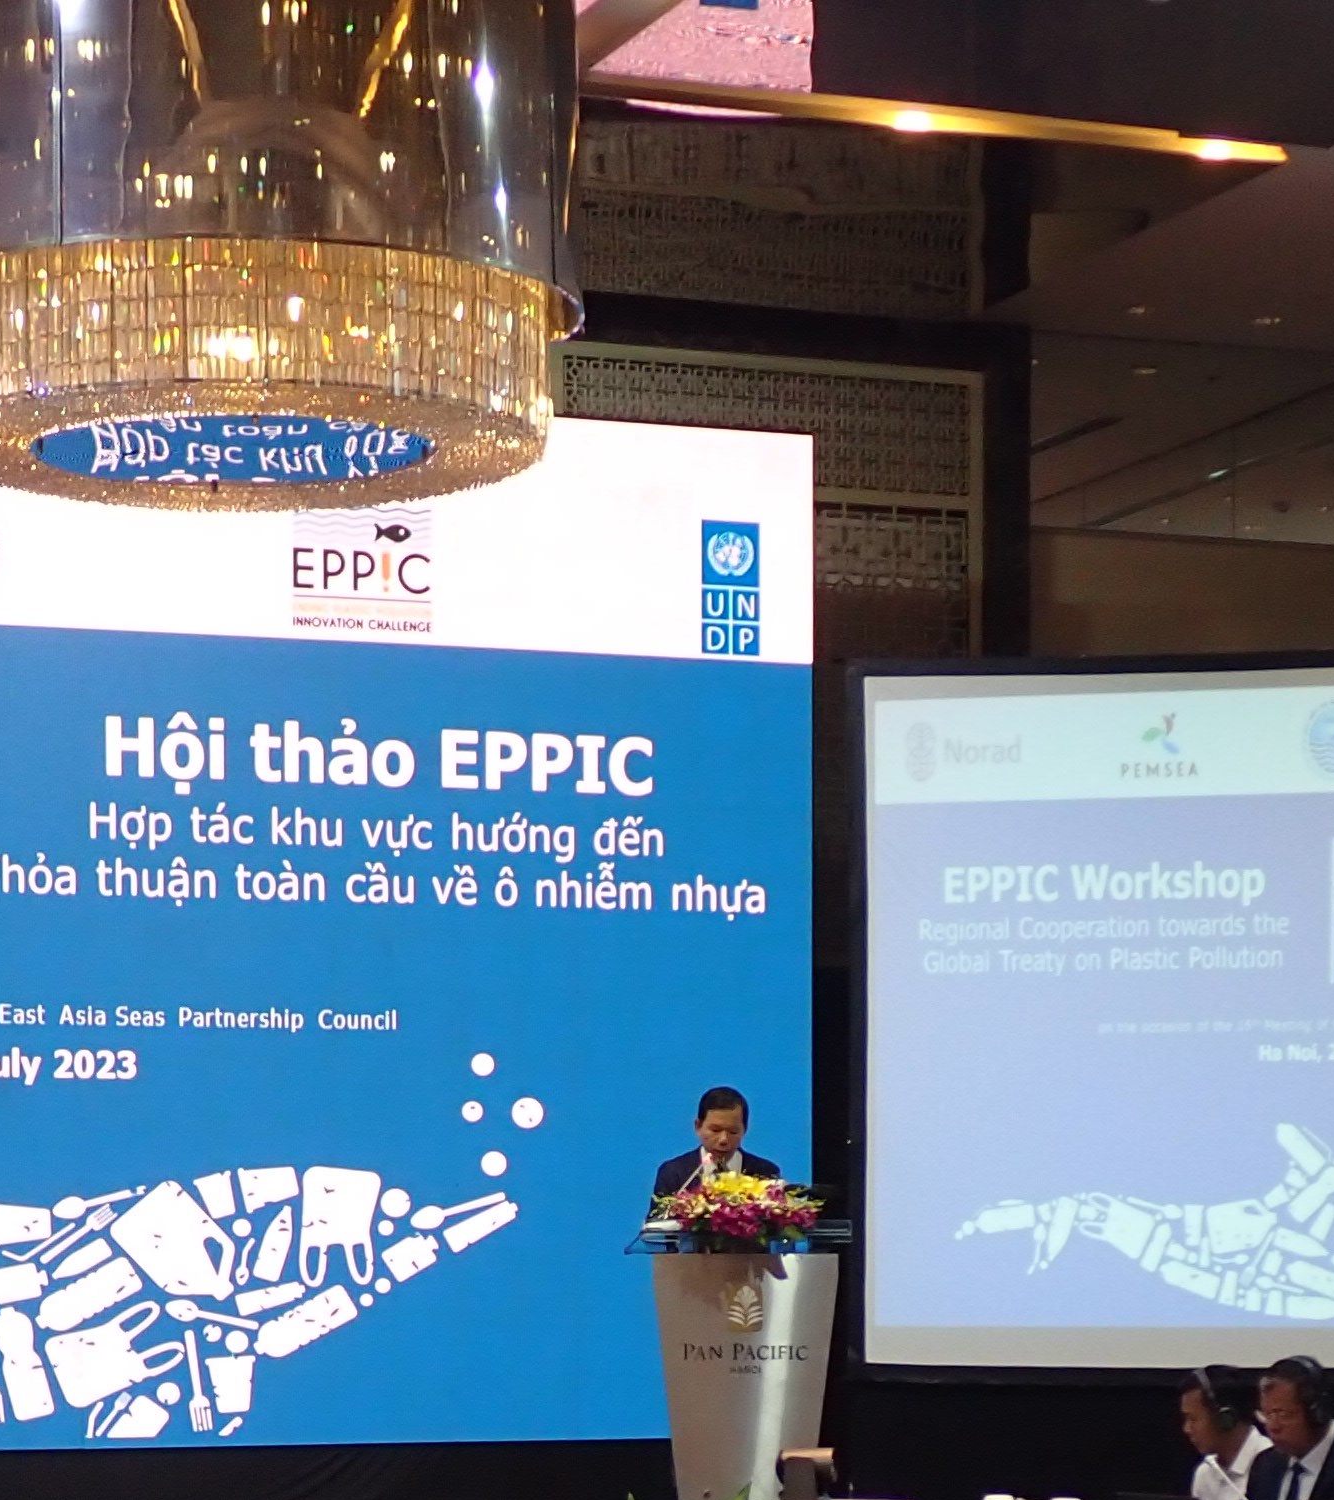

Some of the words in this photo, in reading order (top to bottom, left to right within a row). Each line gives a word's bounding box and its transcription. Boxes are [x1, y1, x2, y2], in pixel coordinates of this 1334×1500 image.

[293, 616, 364, 629] INNOVATION
[369, 619, 432, 633] CHALLENGE
[104, 712, 226, 795] Hội
[249, 716, 415, 788] thảo
[440, 727, 655, 797] EPPIC
[944, 736, 1021, 765] Norad
[1121, 762, 1200, 778] PEMSEA
[88, 802, 171, 848] Hợp
[190, 805, 254, 846] tác
[271, 806, 343, 848] khu
[364, 812, 432, 856] vực
[451, 812, 575, 864] hướng
[594, 815, 664, 858] đến
[95, 855, 217, 905] thuận
[236, 858, 325, 902] toàn
[345, 857, 416, 905] cầu
[432, 860, 478, 907] về
[495, 873, 518, 908] ô
[535, 861, 652, 911] nhiễm
[671, 876, 767, 918] nhựa
[944, 864, 1059, 903] EPPIC
[1071, 861, 1266, 906] Workshop
[919, 916, 1010, 943] Regional
[1019, 914, 1150, 942] Cooperation
[1158, 914, 1246, 938] towards
[1254, 912, 1290, 936] the
[923, 950, 990, 975] Global
[1000, 948, 1066, 977] Treaty
[1075, 954, 1101, 972] on
[1111, 946, 1180, 971] Plastic
[1189, 945, 1284, 969] Pollution
[59, 1003, 107, 1027] Asia
[115, 1005, 166, 1028] Seas
[179, 1007, 304, 1033] Partnership
[318, 1009, 397, 1031] Council
[53, 1049, 137, 1080] 2023
[1259, 1044, 1282, 1061] Ha
[1288, 1042, 1322, 1063] Noi,
[683, 1343, 723, 1361] PAN
[733, 1343, 809, 1361] PACIFIC
